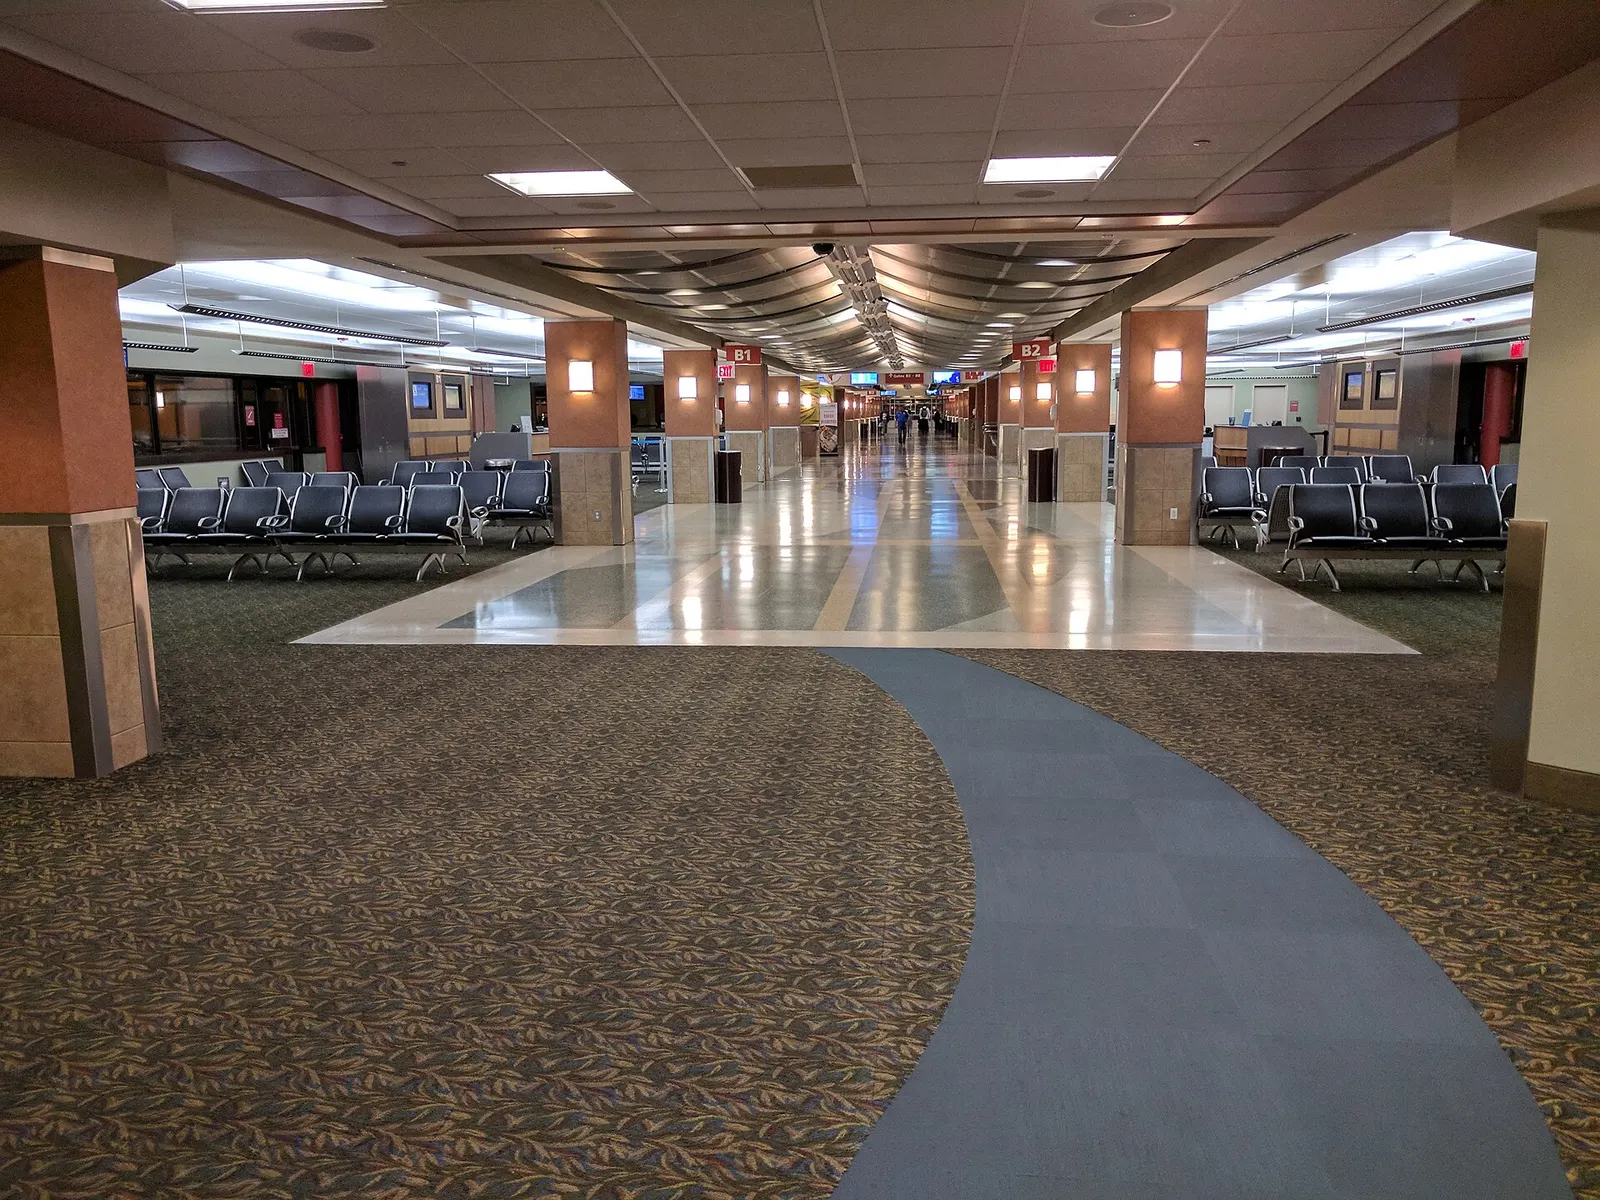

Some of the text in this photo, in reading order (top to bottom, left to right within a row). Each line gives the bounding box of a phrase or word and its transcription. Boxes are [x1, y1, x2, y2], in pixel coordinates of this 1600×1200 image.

[734, 349, 751, 361] B1
[1021, 344, 1041, 357] B2
[719, 365, 733, 377] EXIT
